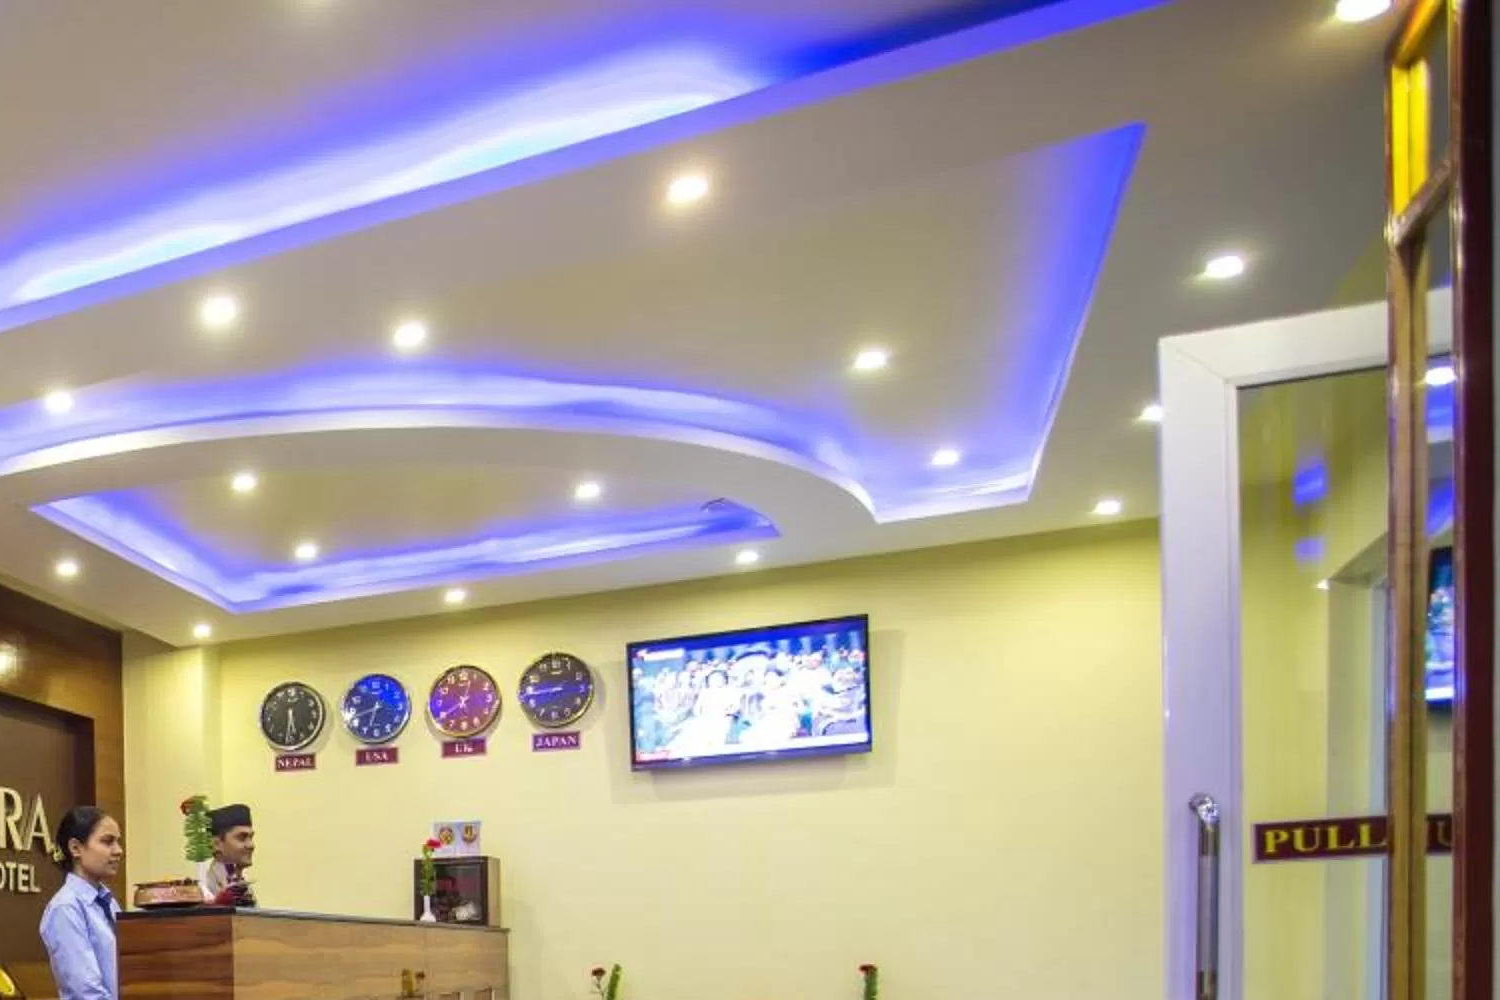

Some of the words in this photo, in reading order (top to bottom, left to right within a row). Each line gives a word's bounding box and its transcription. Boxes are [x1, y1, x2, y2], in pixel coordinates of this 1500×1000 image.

[535, 735, 578, 748] JAPAN
[277, 757, 312, 769] NEPAL
[1265, 823, 1388, 853] PULL
